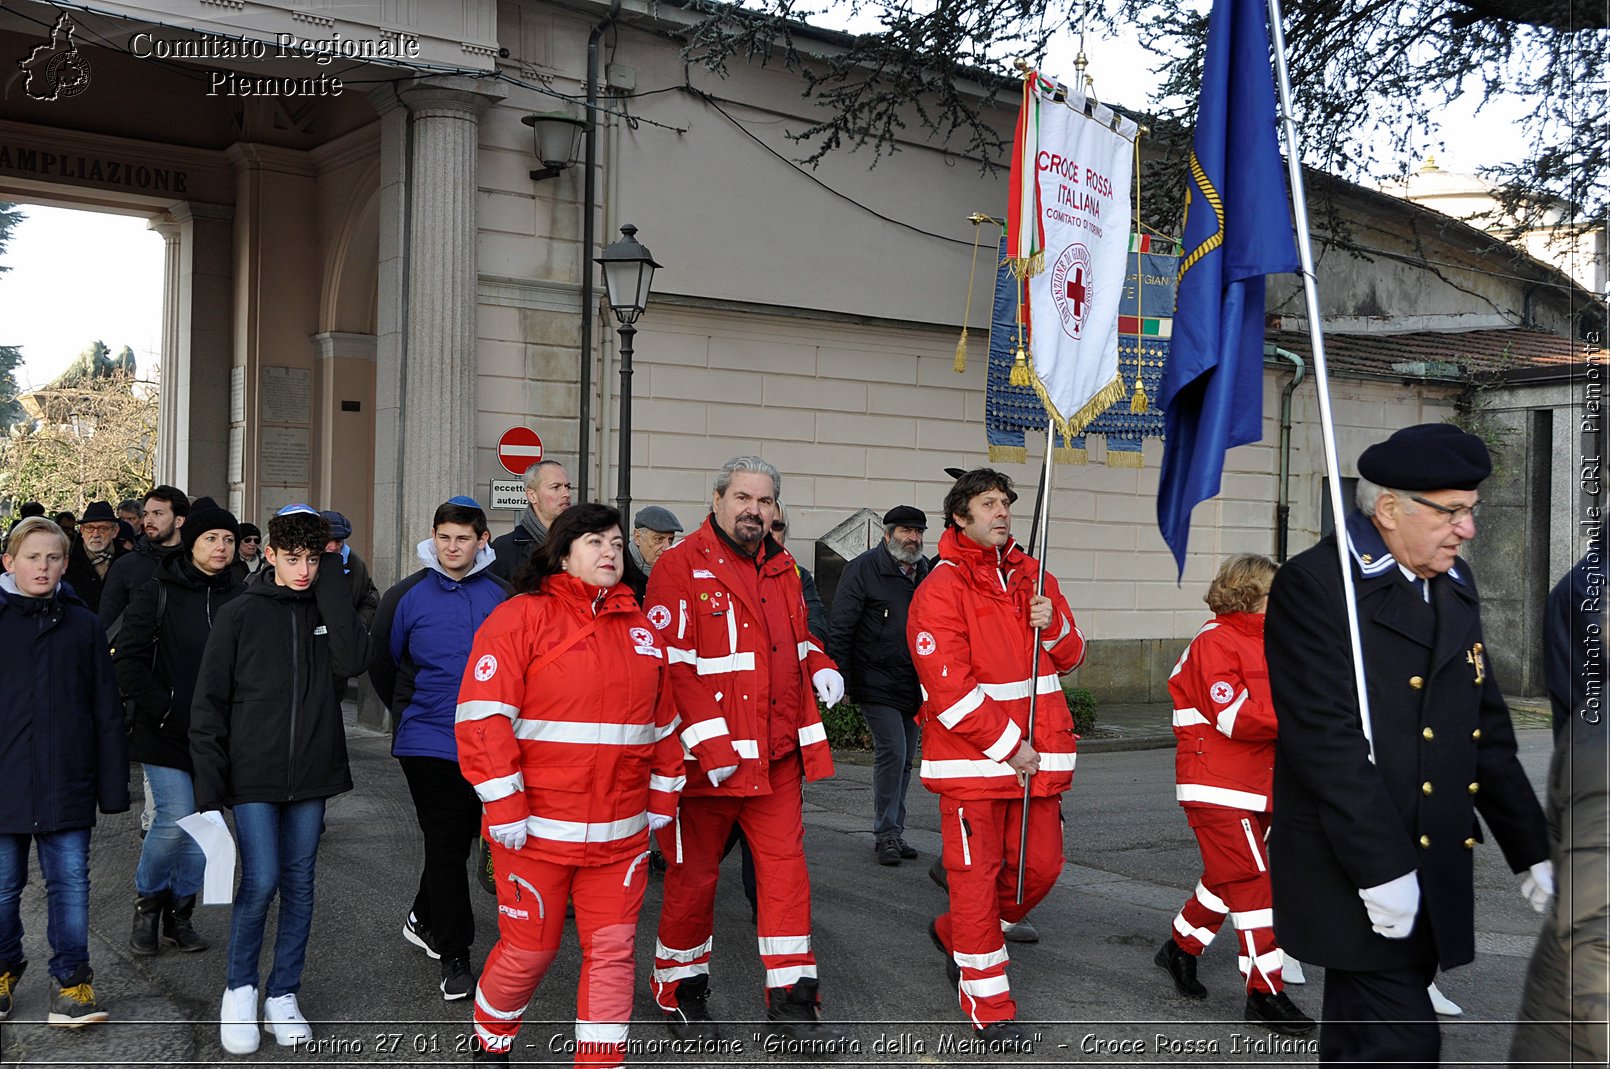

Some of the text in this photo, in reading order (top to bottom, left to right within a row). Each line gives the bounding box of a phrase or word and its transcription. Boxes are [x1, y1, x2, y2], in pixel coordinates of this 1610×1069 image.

[0, 145, 187, 193] AMPLIAZIONE
[1038, 150, 1113, 200] CROCE ROSSA
[1057, 184, 1100, 219] ITALIANA
[1046, 208, 1103, 239] COMITATO DI TORINO
